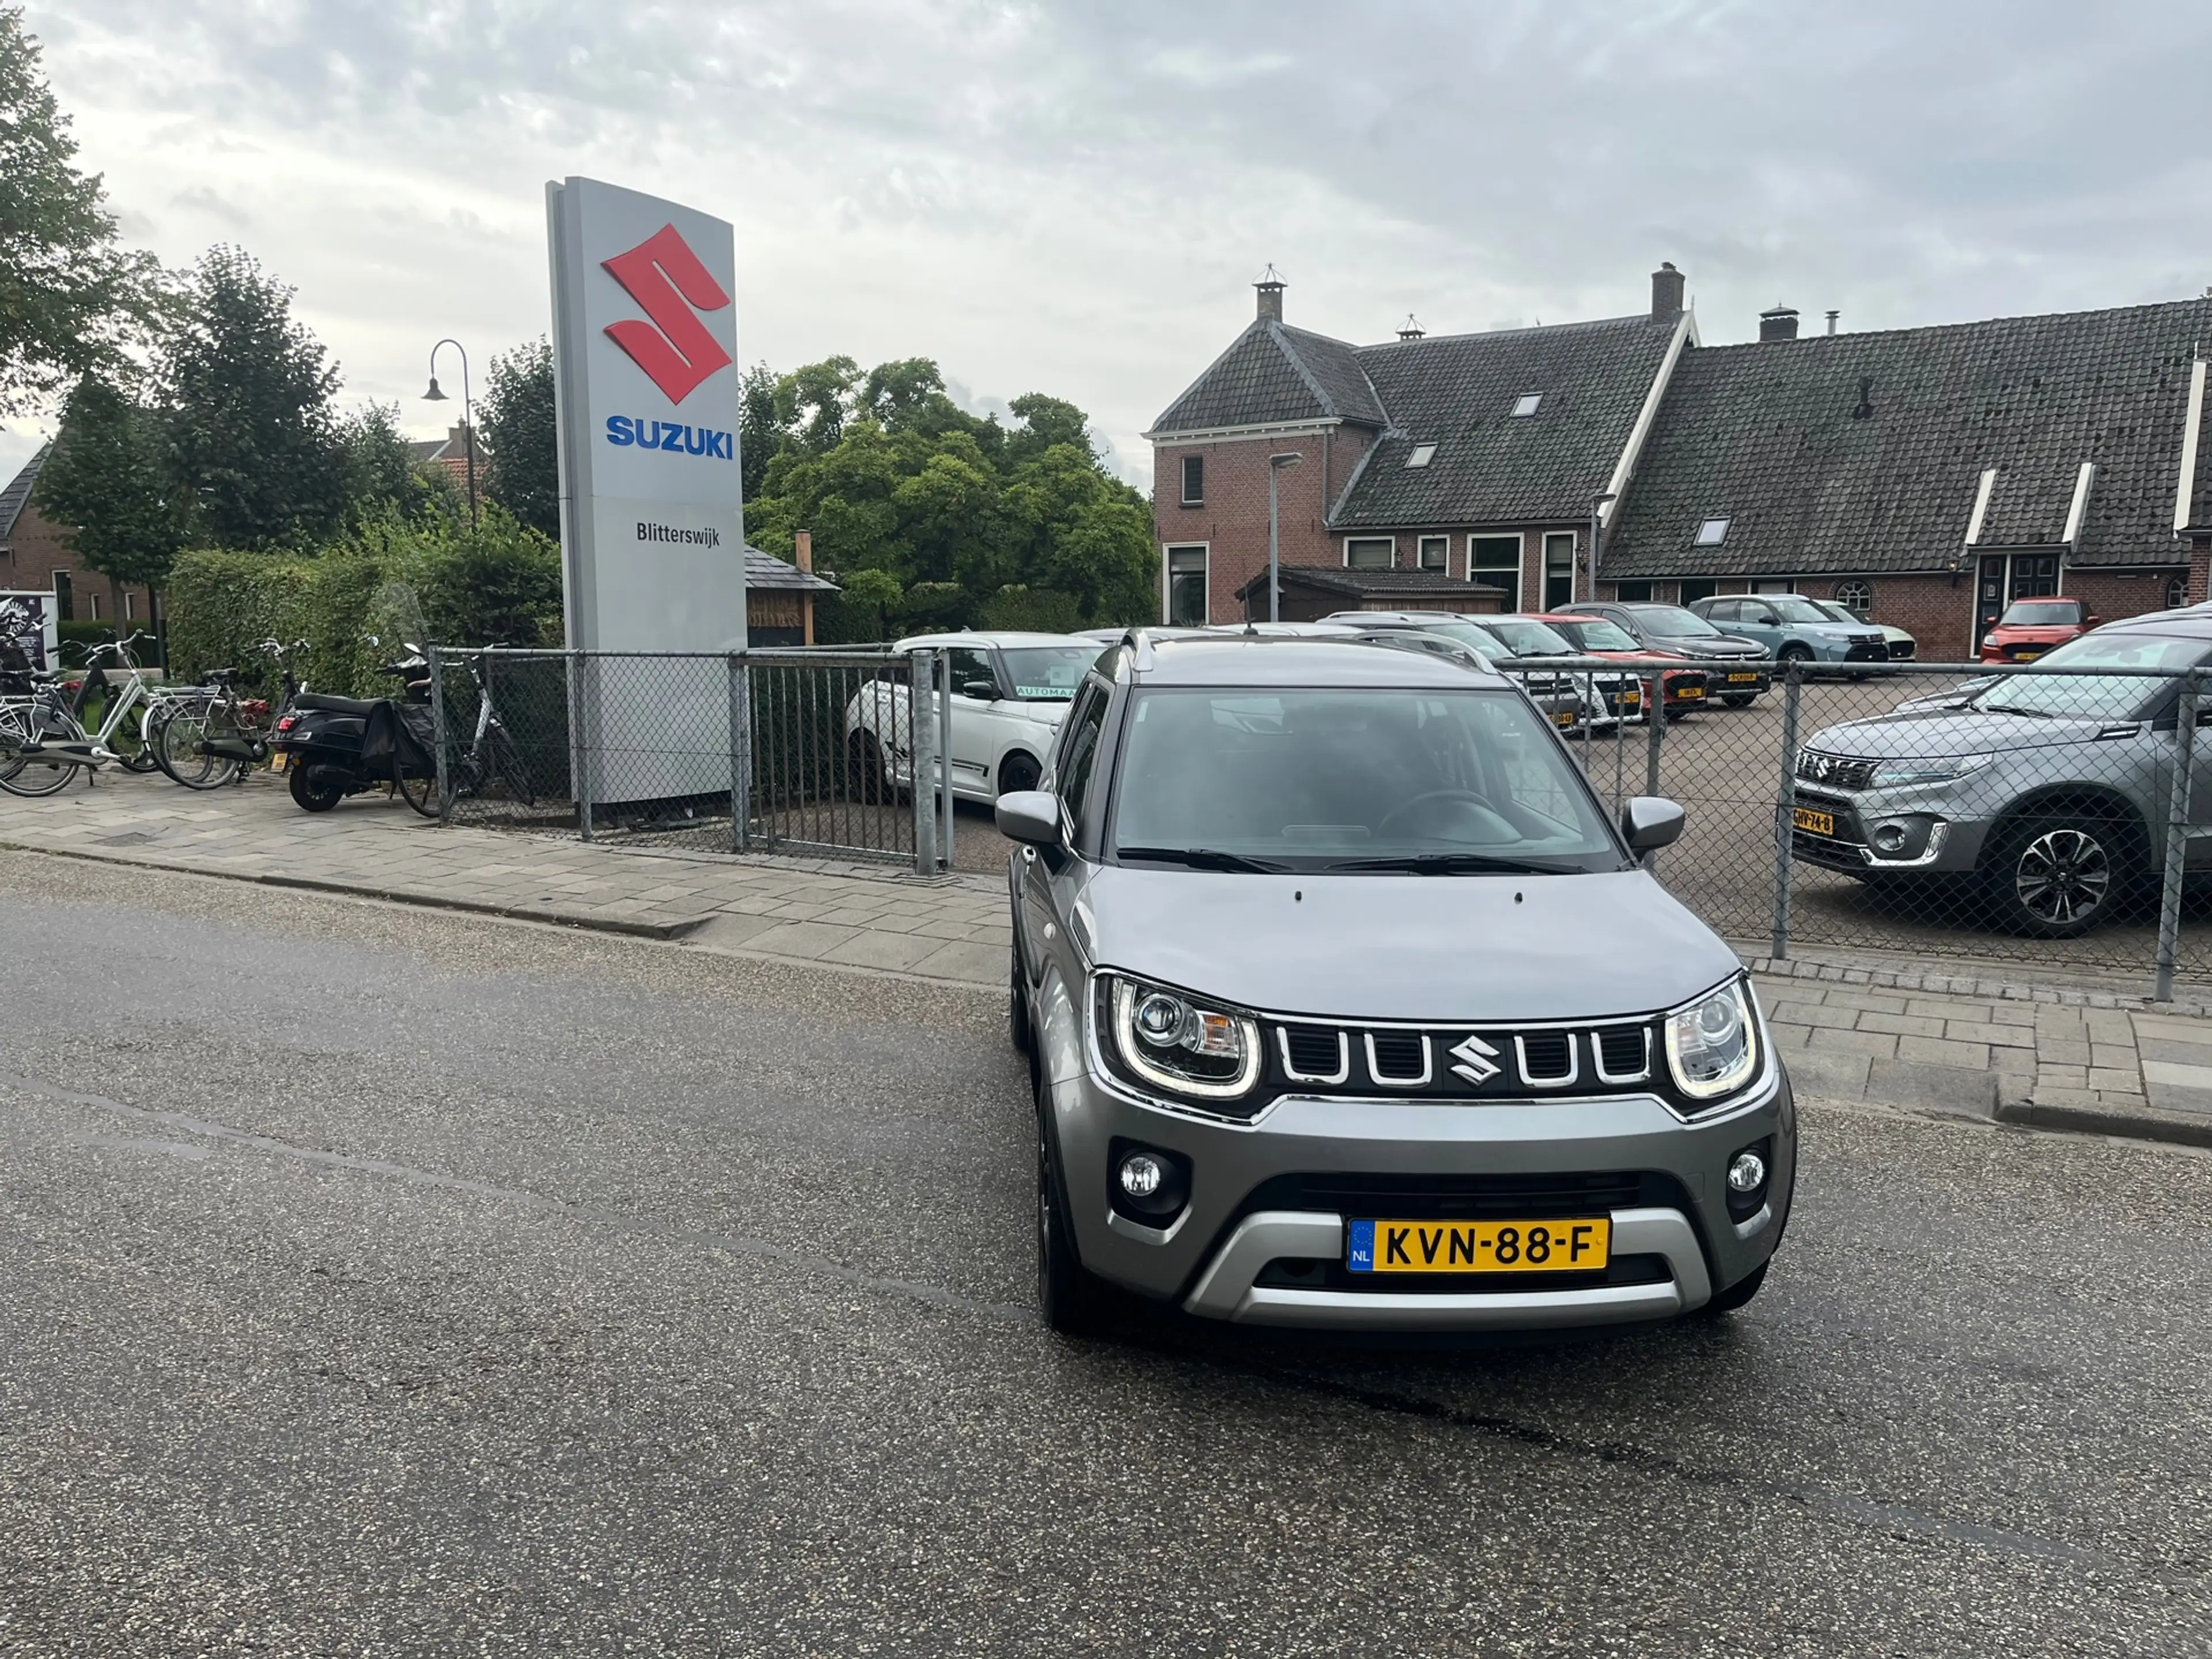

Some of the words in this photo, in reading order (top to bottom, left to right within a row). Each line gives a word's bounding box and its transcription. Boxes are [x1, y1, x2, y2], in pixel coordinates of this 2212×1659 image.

[607, 415, 733, 460] SUZUKI
[637, 522, 720, 549] Blitterswijk
[1353, 1250, 1370, 1262] NL
[1387, 1226, 1593, 1264] KVN-88-F
